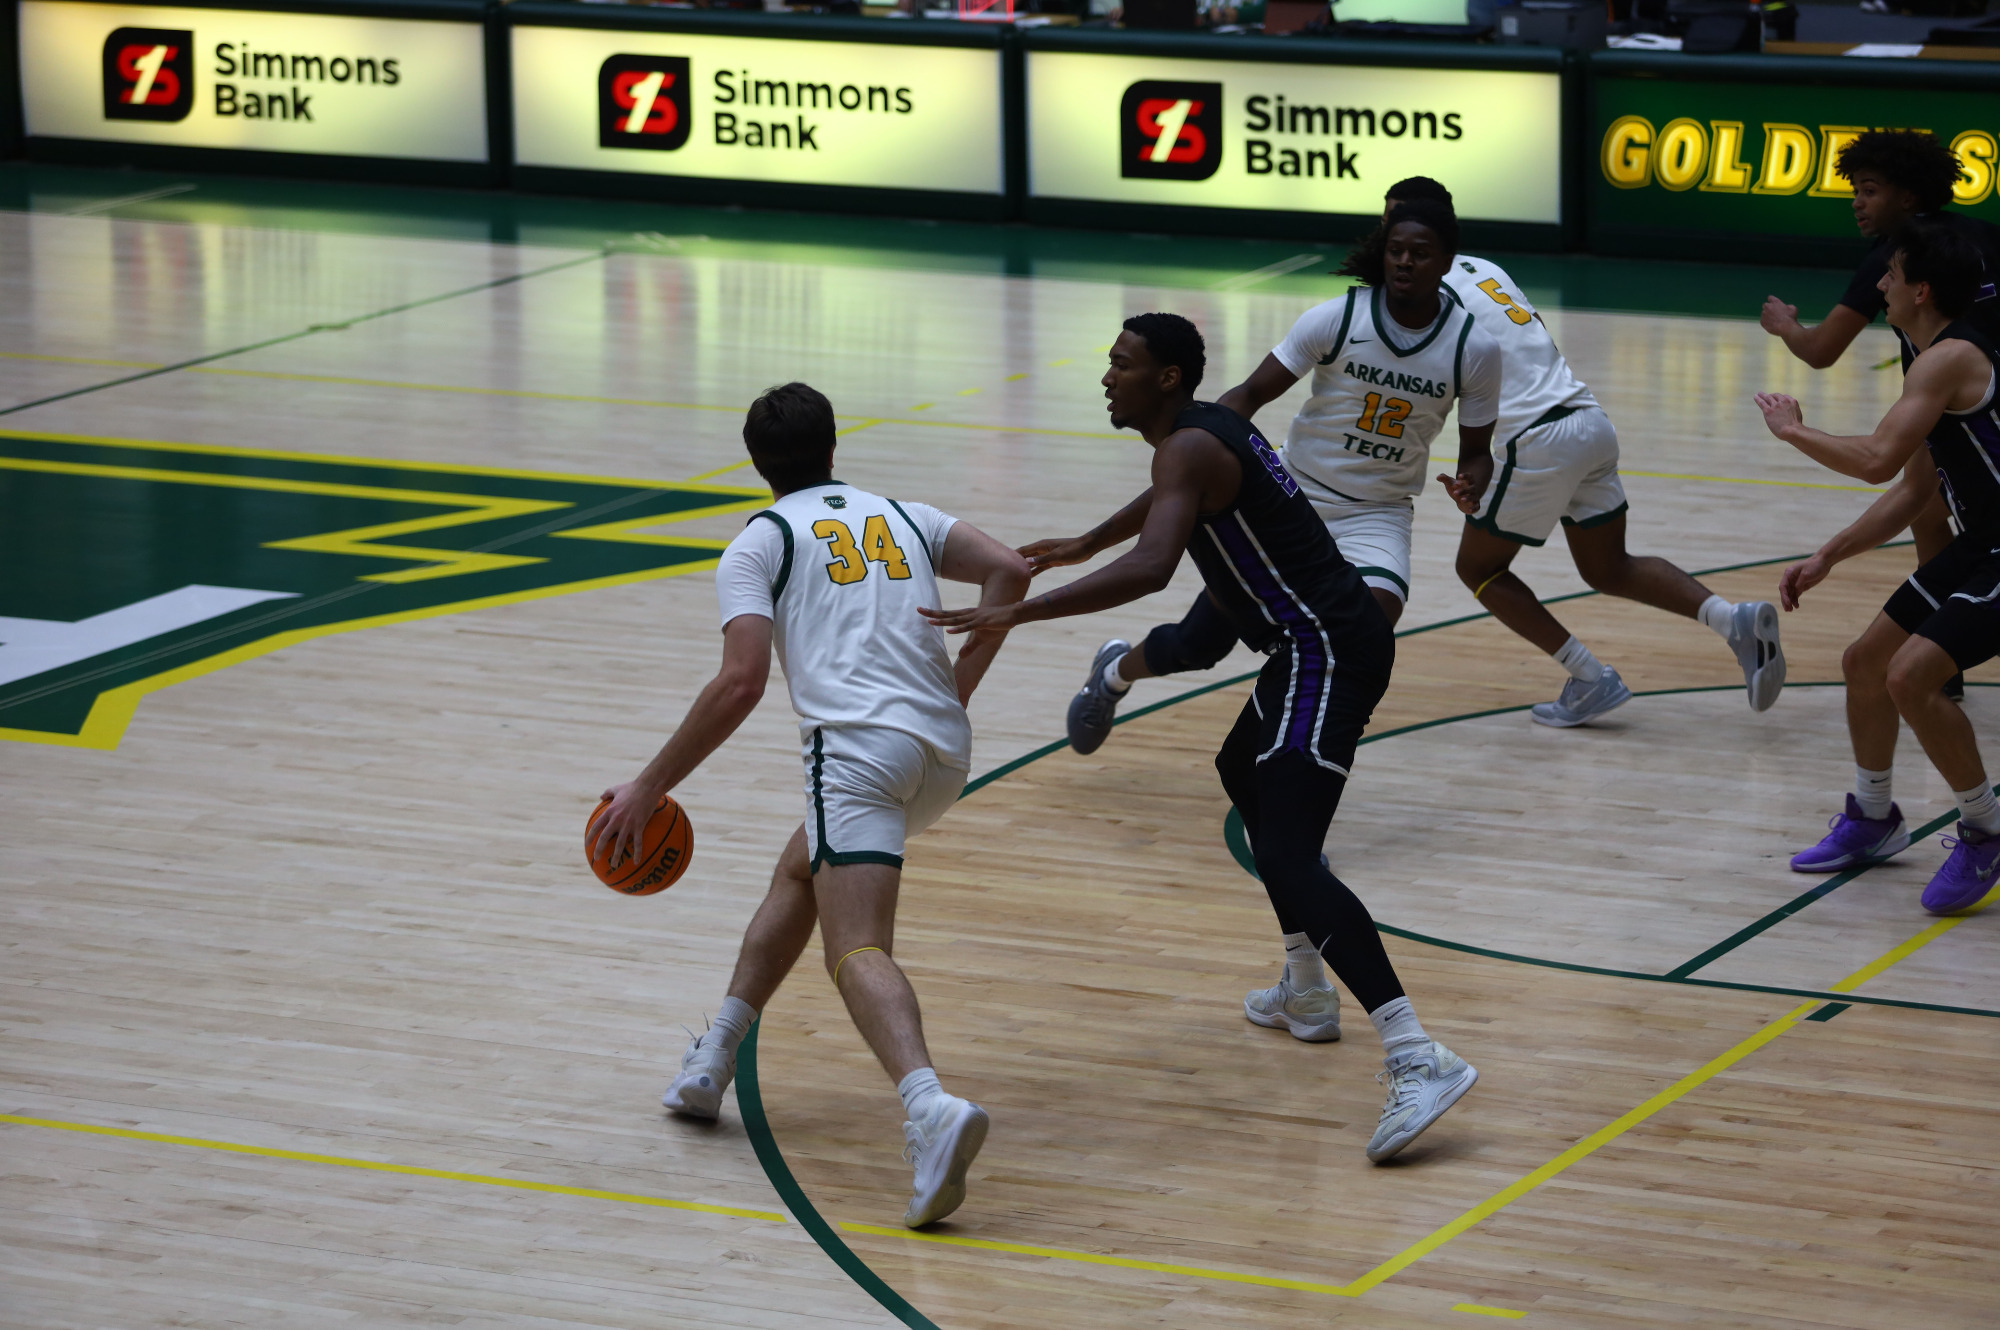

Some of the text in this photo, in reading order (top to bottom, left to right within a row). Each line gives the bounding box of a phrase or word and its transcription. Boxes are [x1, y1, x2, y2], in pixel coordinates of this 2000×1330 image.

[215, 43, 400, 85] Simmons
[215, 83, 312, 121] Bank
[714, 70, 913, 113] Simmons
[714, 112, 818, 150] Bank
[1245, 94, 1463, 140] Simmons
[1246, 138, 1360, 179] Bank
[1600, 113, 1934, 199] GOLDE
[1476, 277, 1532, 326] 5
[1343, 361, 1447, 399] ARKANSAS
[1355, 391, 1414, 439] 12
[1343, 434, 1406, 463] TECH
[811, 515, 912, 585] 34
[623, 847, 681, 894] Wilson
